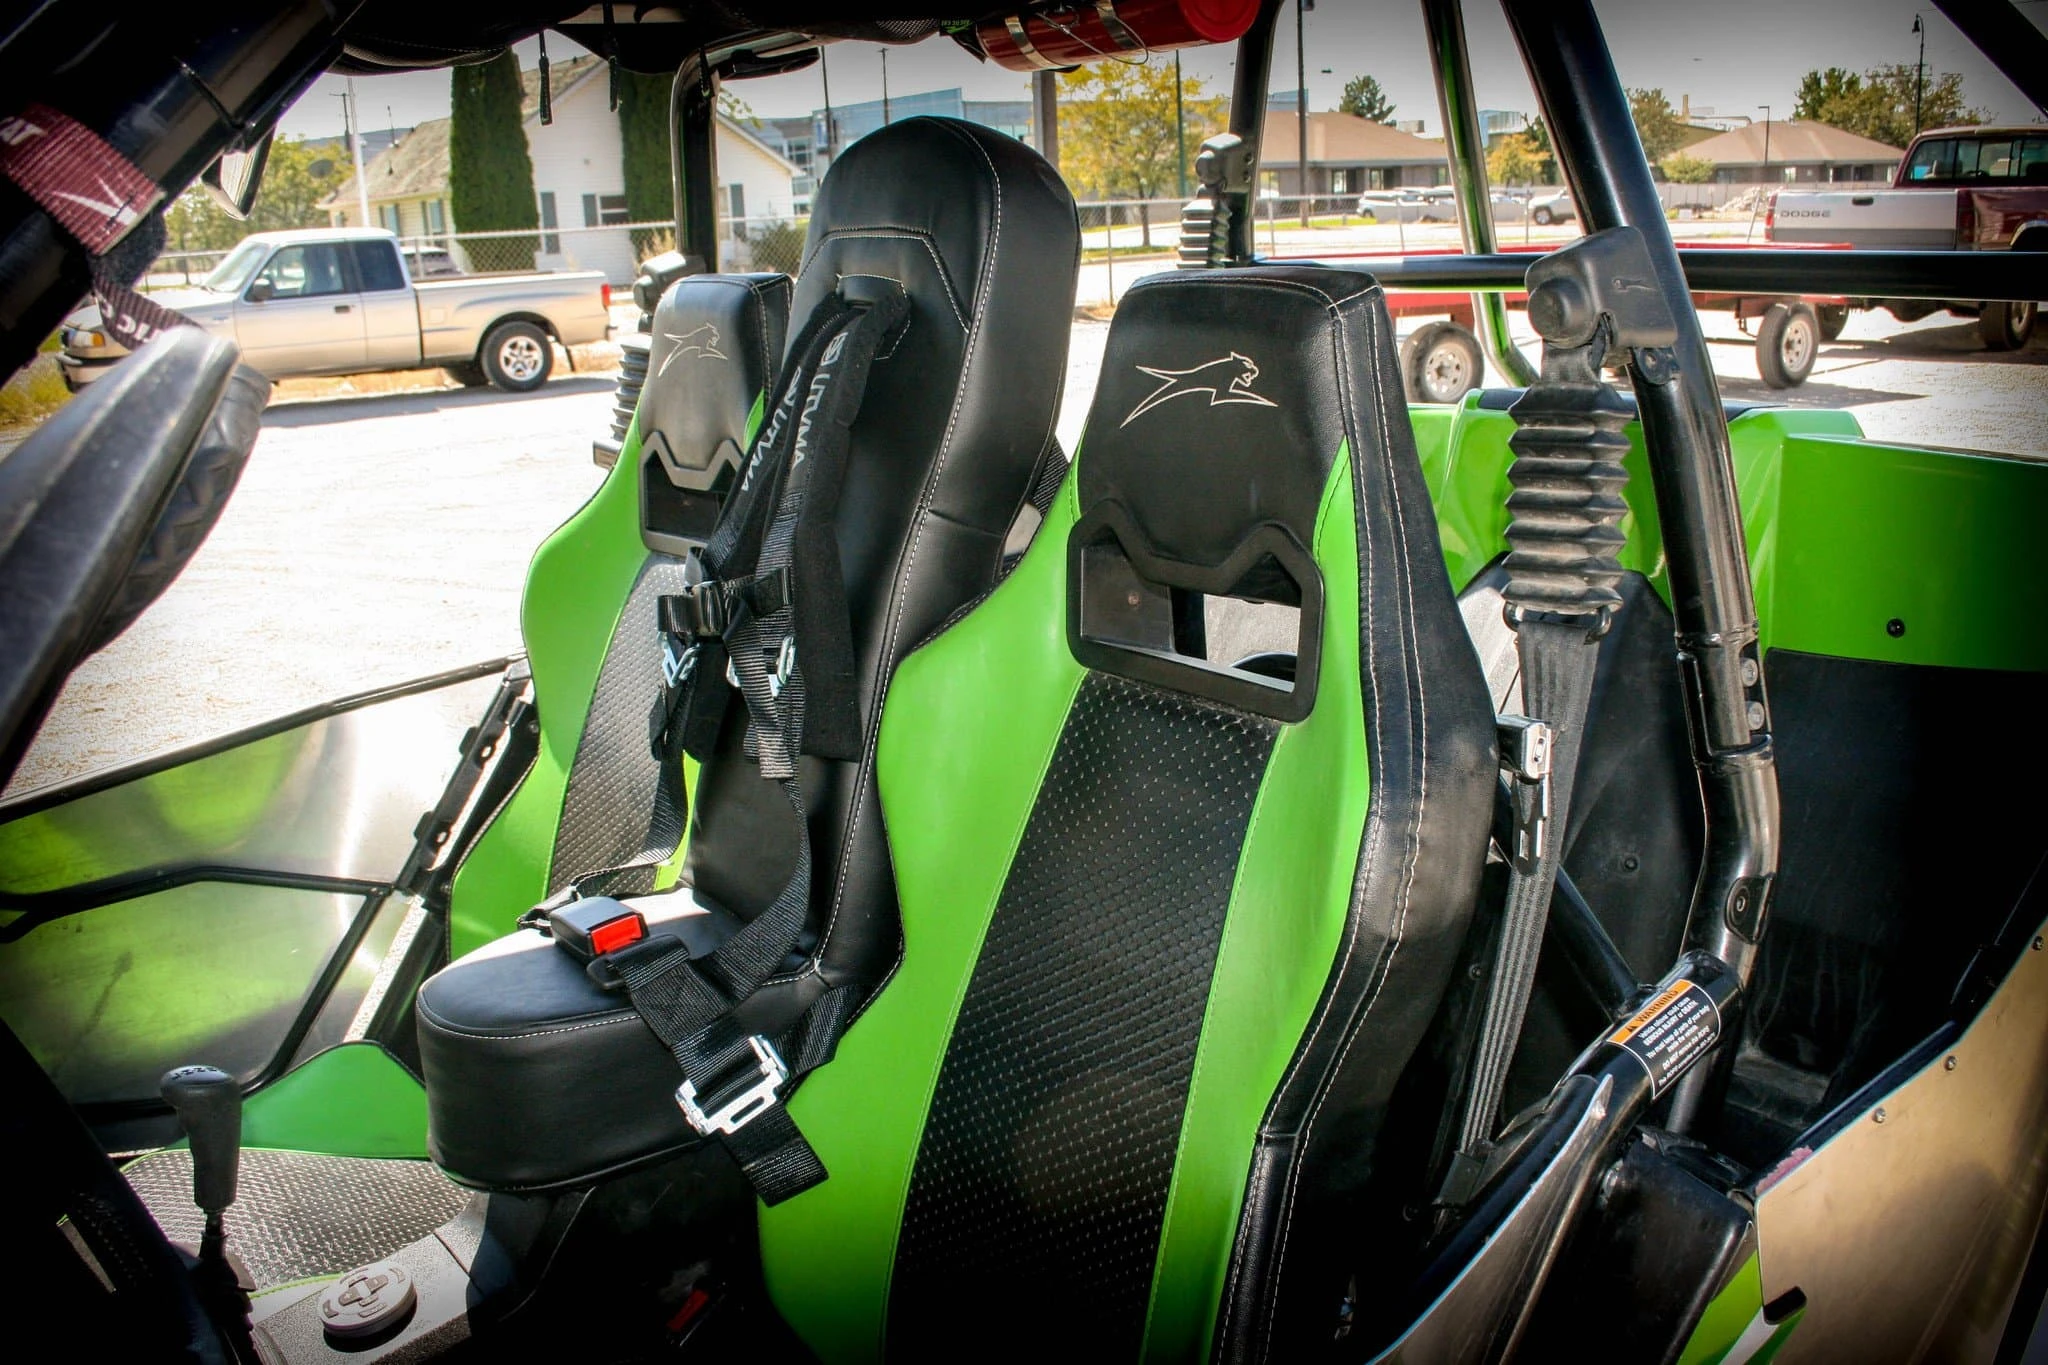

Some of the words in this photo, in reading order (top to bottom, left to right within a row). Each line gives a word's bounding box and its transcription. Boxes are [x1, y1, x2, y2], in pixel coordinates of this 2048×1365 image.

[1780, 210, 1831, 218] DODGE
[792, 373, 831, 470] UTVMA
[1638, 990, 1679, 1022] WARNING
[1662, 1015, 1679, 1031] INJURY
